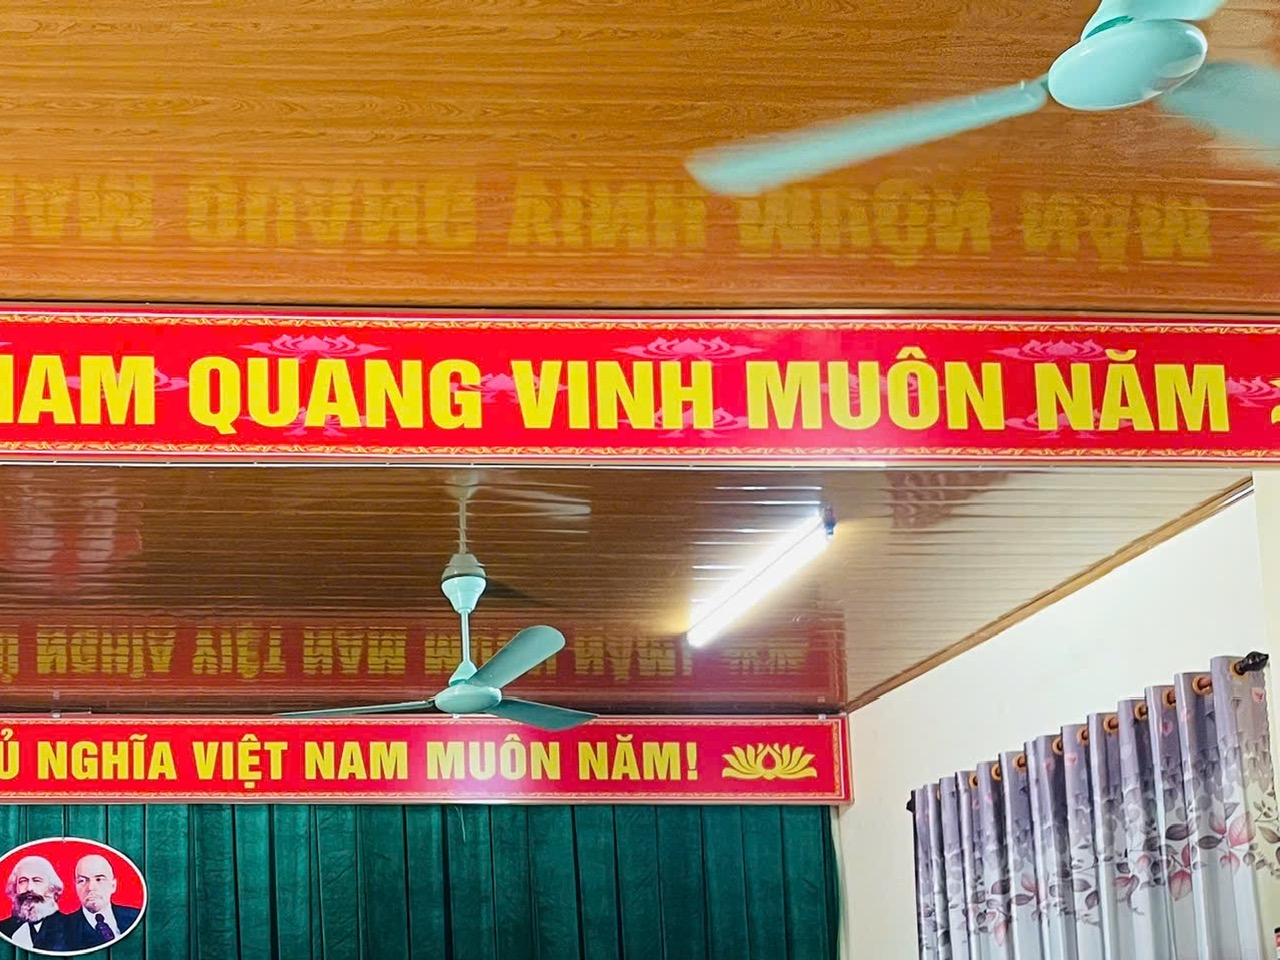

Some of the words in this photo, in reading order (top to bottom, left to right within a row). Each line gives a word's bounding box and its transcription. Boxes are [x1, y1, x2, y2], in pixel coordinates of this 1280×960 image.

[188, 357, 482, 434] QUANG
[511, 360, 715, 430] VINH
[745, 347, 1005, 431] MUÔN
[1034, 349, 1230, 432] NĂM
[37, 734, 177, 780] NGHĨA
[192, 733, 289, 789] VIỆT
[305, 741, 409, 780] NAM
[426, 733, 561, 780] MUÔN
[578, 733, 699, 780] NĂM!
